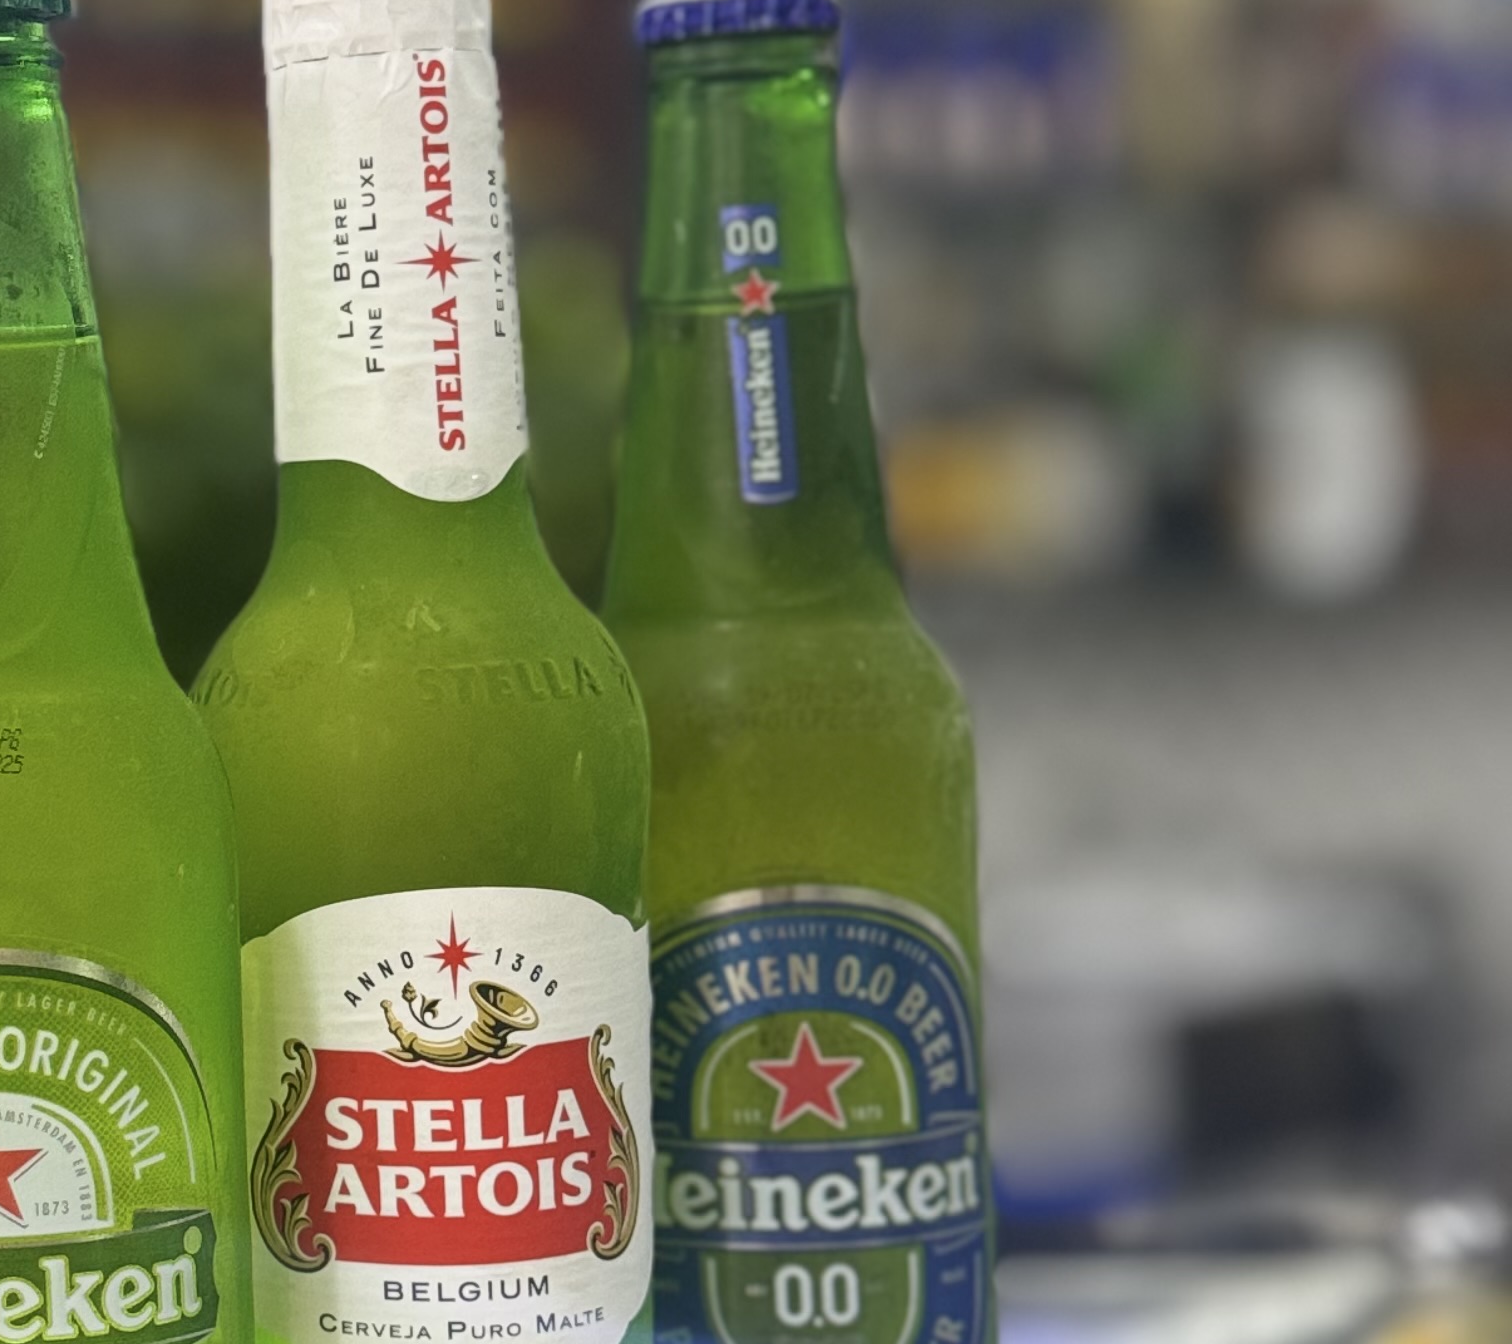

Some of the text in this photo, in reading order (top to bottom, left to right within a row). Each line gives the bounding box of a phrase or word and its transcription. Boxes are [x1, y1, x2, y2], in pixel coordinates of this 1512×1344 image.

[417, 57, 466, 452] STELLA ARTOIS
[487, 169, 506, 338] FEITA COM
[745, 327, 782, 483] Heineken
[342, 947, 559, 1009] ANNO 1366
[16, 992, 78, 1015] LAGER
[86, 1009, 128, 1037] BEER
[653, 952, 958, 1100] HEINEKEN 0.0 BEER
[324, 1088, 591, 1153] STELLA
[72, 1158, 88, 1178] EN
[323, 1151, 593, 1218] ARTOIS
[34, 1200, 70, 1217] 1873
[382, 1274, 550, 1304] BELGIUM
[773, 1262, 861, 1329] 0.0
